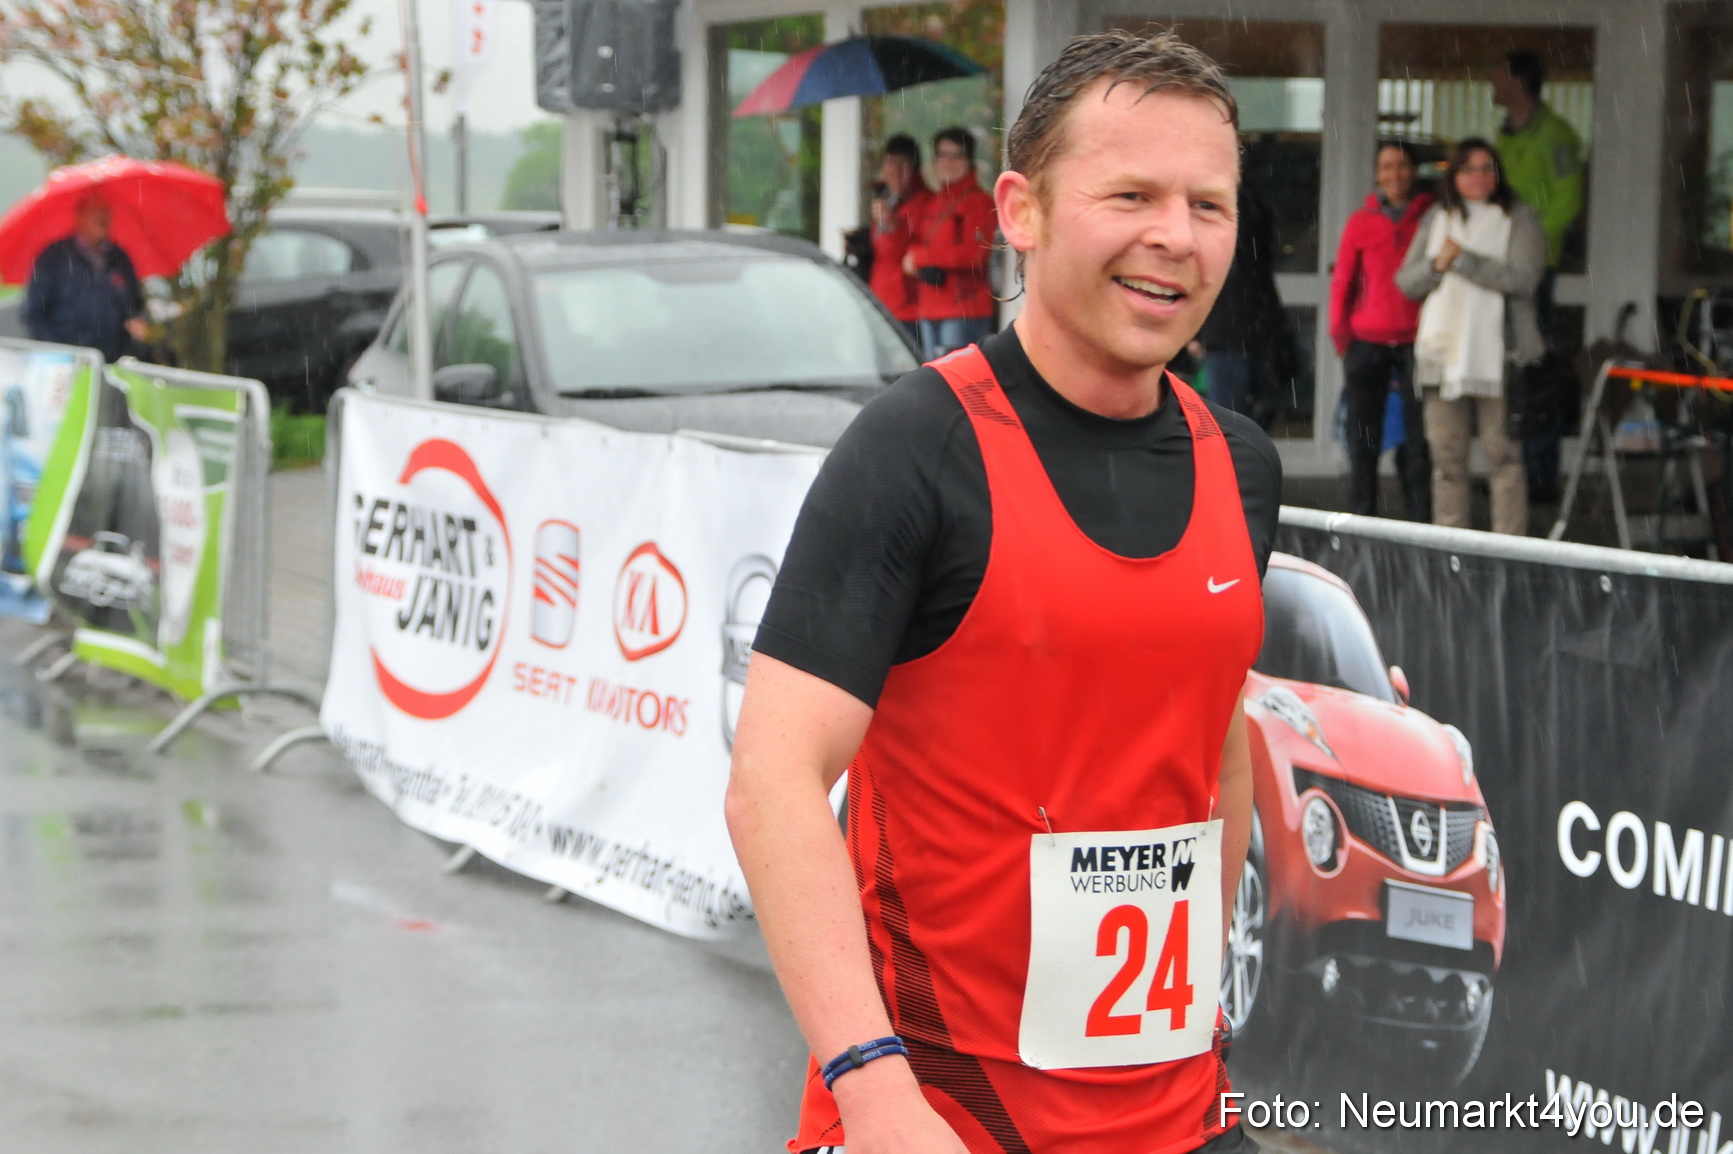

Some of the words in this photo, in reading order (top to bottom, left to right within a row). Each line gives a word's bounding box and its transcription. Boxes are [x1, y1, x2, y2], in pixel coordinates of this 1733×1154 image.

[513, 661, 577, 706] SEAT
[1070, 843, 1166, 873] MEYER
[1070, 871, 1167, 894] WERBUNG
[1085, 899, 1194, 1038] 24
